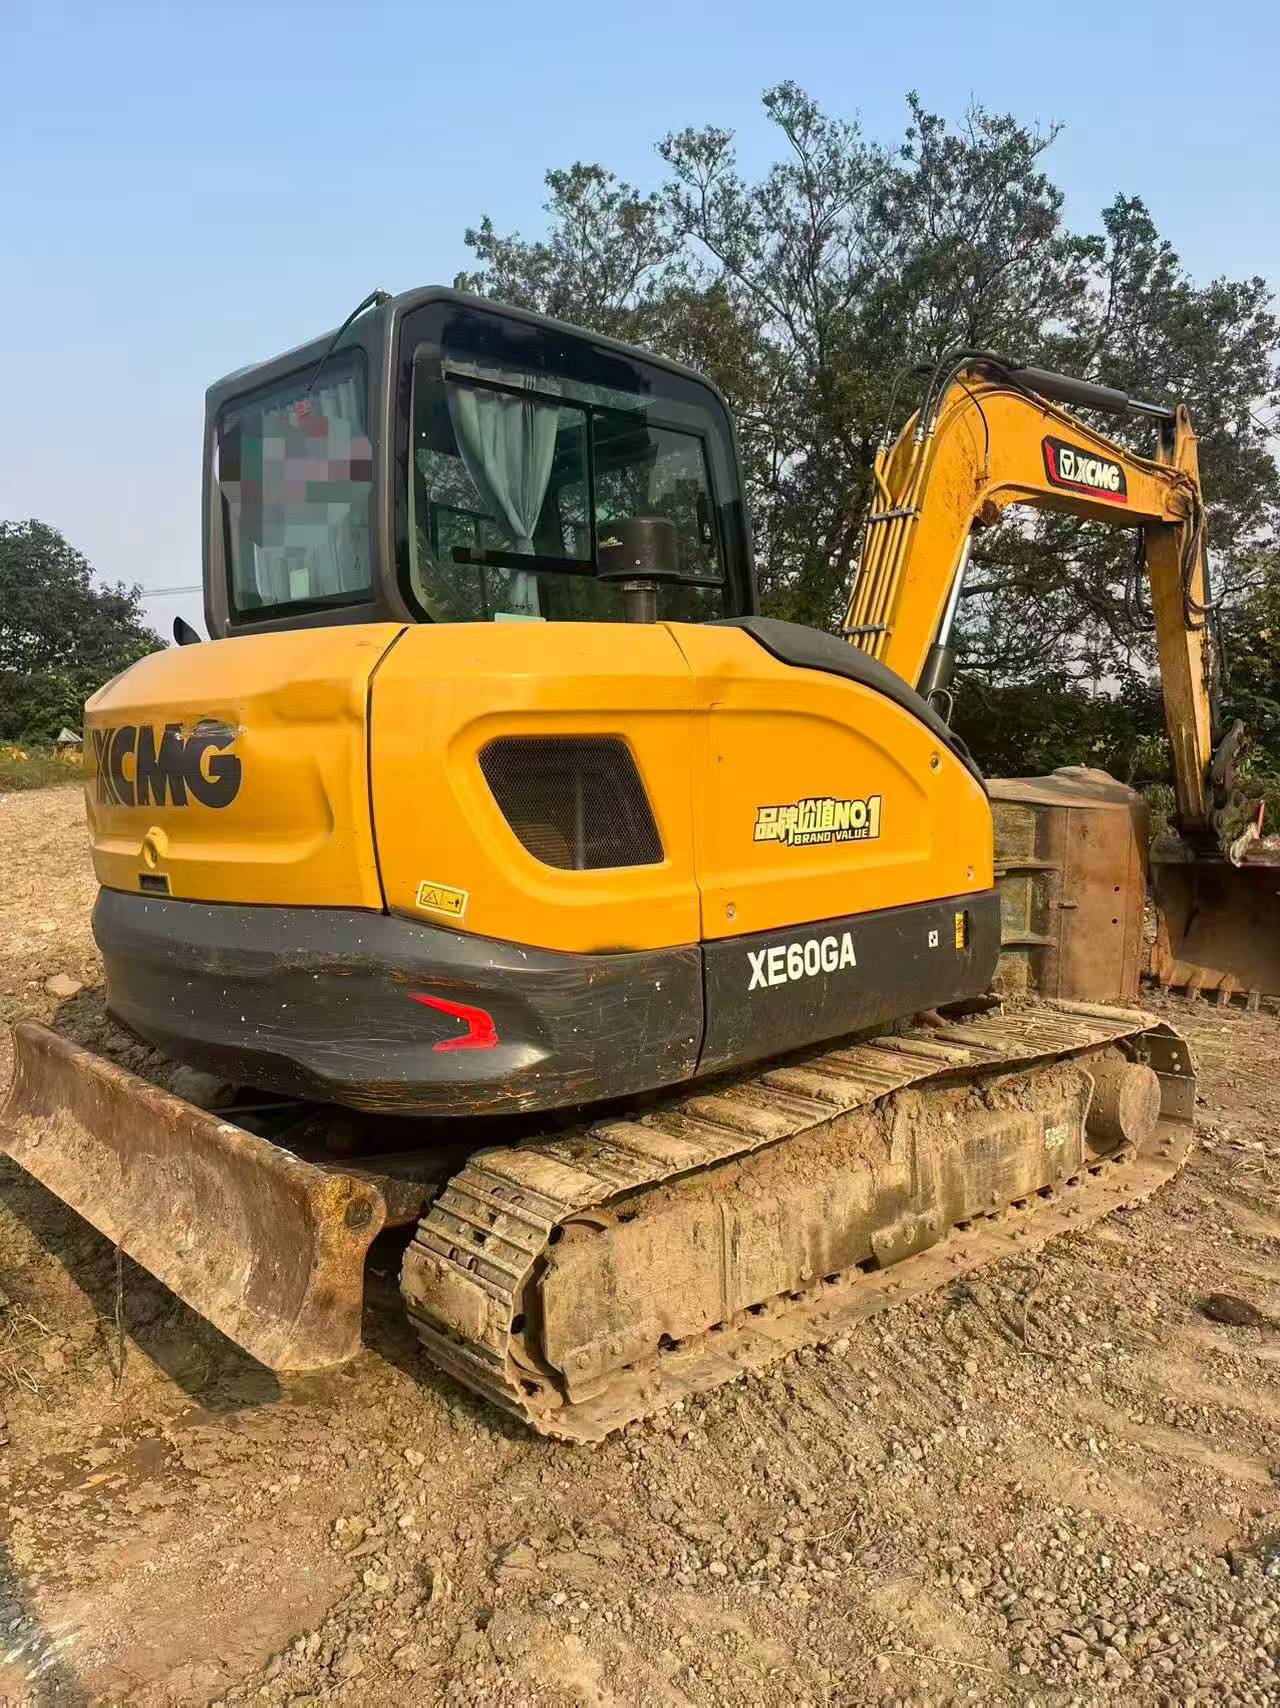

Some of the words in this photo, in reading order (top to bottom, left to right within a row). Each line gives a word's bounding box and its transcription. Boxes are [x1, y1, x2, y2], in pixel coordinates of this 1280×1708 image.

[1075, 456, 1120, 491] XCMG
[93, 718, 242, 808] XCMG
[794, 832, 831, 845] BRAND
[836, 828, 868, 840] VALUE
[747, 932, 857, 990] XE60GA
